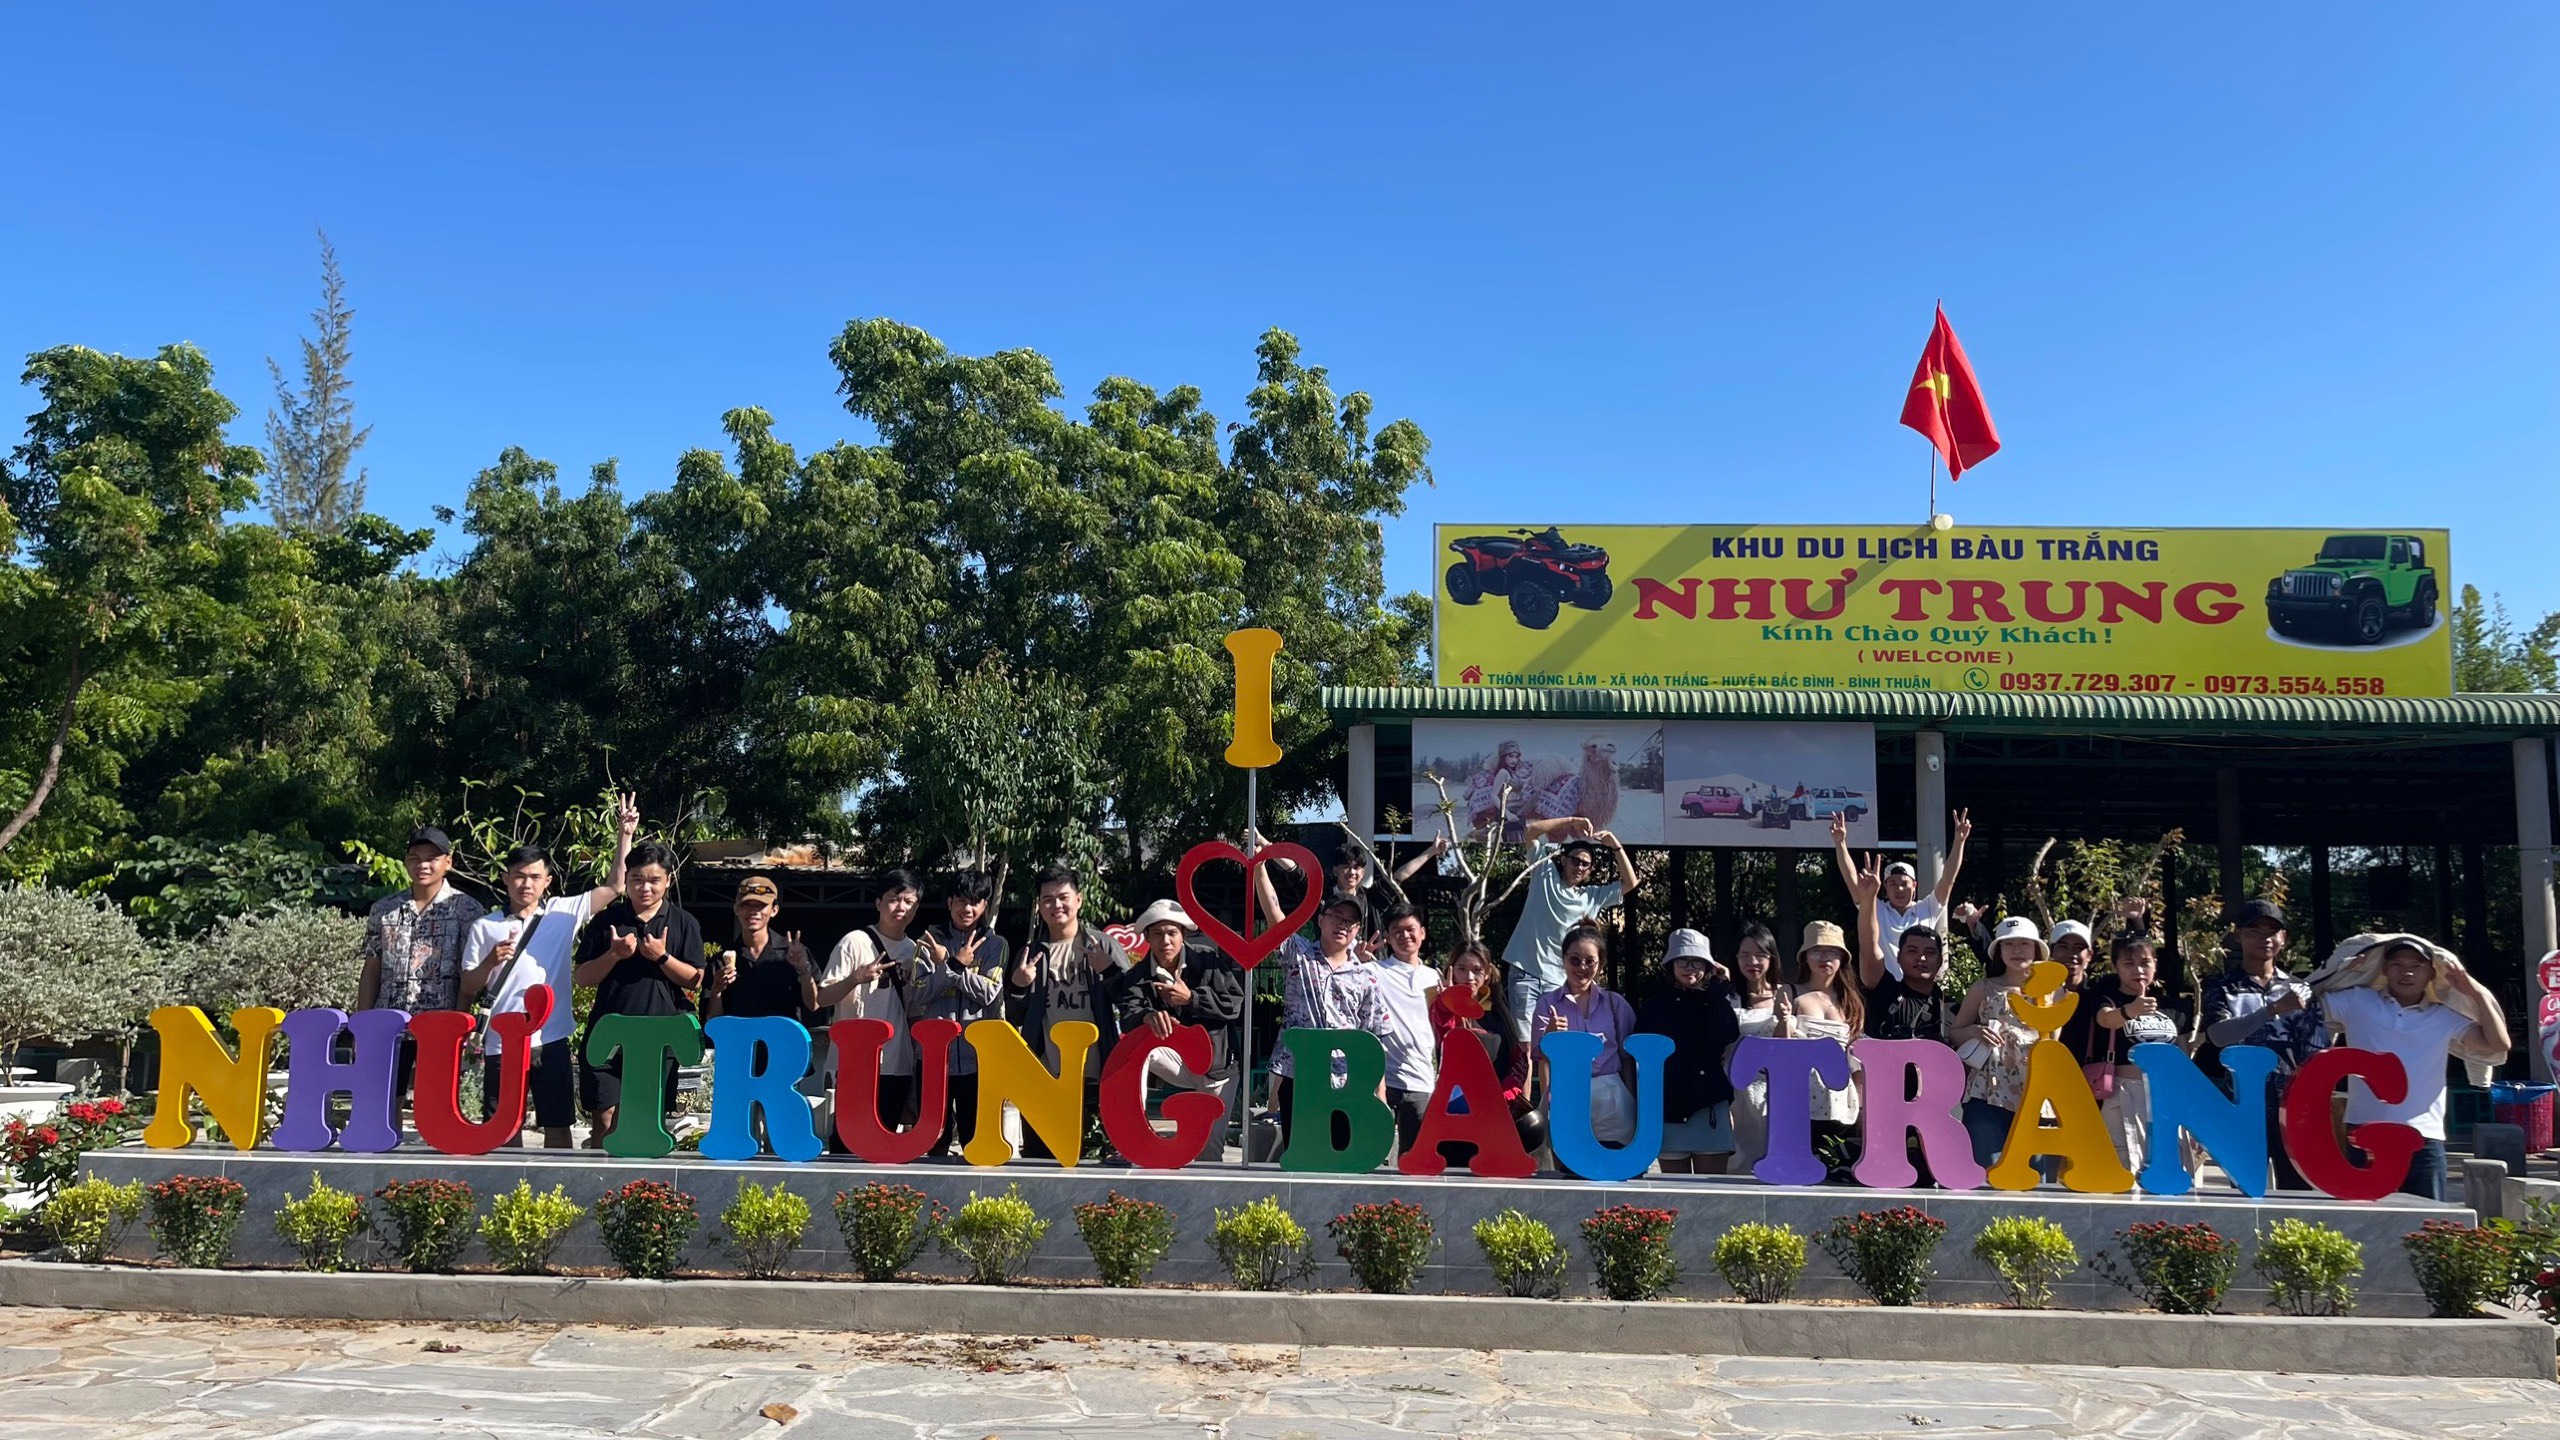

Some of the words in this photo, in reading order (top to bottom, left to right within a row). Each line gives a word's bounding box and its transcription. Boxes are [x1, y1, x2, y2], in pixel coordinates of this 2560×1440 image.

[1713, 537, 1783, 558] KHU
[1798, 538, 1844, 559] DU
[1858, 538, 1937, 563] LỊCH
[1951, 534, 2024, 560] BÀU
[2036, 532, 2158, 561] TRẮNG
[1631, 568, 1858, 620] NHƯ
[1879, 579, 2244, 624] TRUNG
[1762, 623, 1833, 641] Kính
[1844, 625, 1919, 642] Chào
[1930, 625, 1988, 645] Quý
[1487, 671, 1524, 686] THÔN
[1528, 669, 1564, 686] HỒNG
[1568, 671, 1597, 686] LÂM
[1610, 672, 1627, 686] XÃ
[1632, 673, 1659, 686] HÒA
[1663, 671, 1709, 687] THẮNG
[1721, 673, 1767, 689] HUYỆN
[1771, 672, 1799, 687] BẮC
[1803, 673, 1835, 688] BÌNH
[1848, 674, 1881, 688] BÌNH
[1885, 675, 1931, 690] THUẬN
[1999, 672, 2176, 692] 0937.729.307
[2204, 675, 2385, 695] 0973.554.558
[143, 983, 553, 1155] NHƯ
[586, 1012, 1225, 1170] TRUNG
[1280, 983, 1676, 1181] BÀU
[1731, 961, 2426, 1200] TRẮNG
